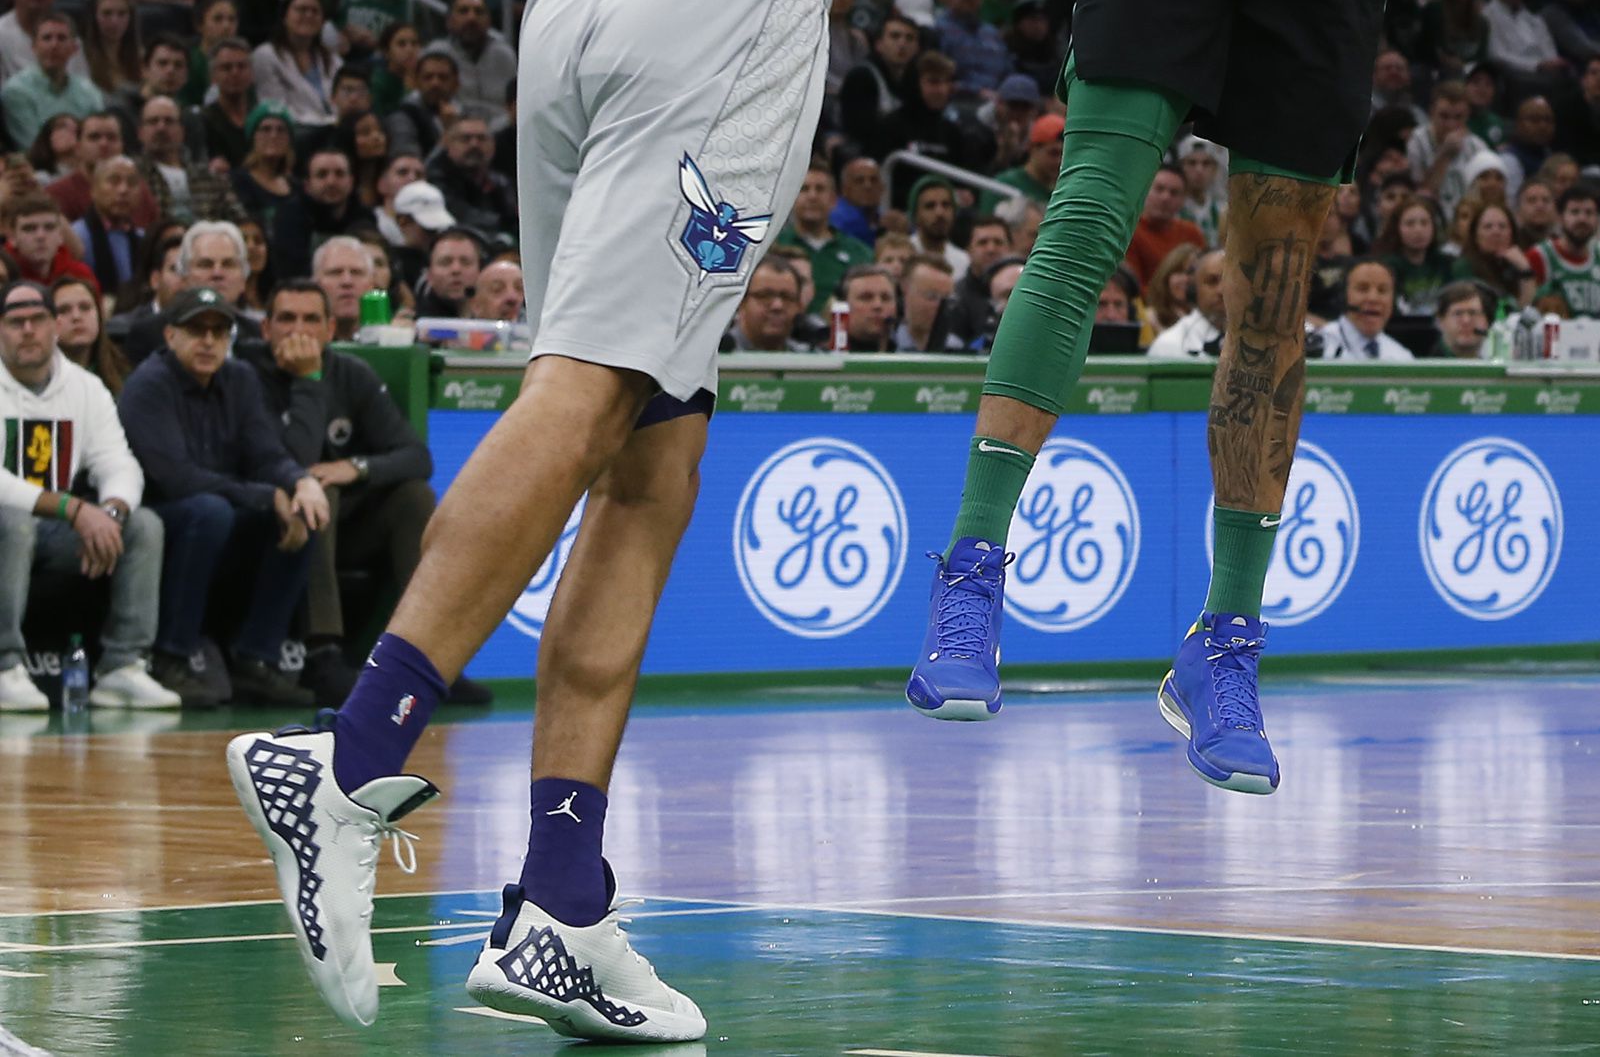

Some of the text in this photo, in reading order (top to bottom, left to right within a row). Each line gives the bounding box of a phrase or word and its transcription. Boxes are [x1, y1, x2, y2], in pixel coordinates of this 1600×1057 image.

[774, 485, 869, 589] GE
[1015, 483, 1102, 584] GE
[1453, 480, 1530, 575] GE
